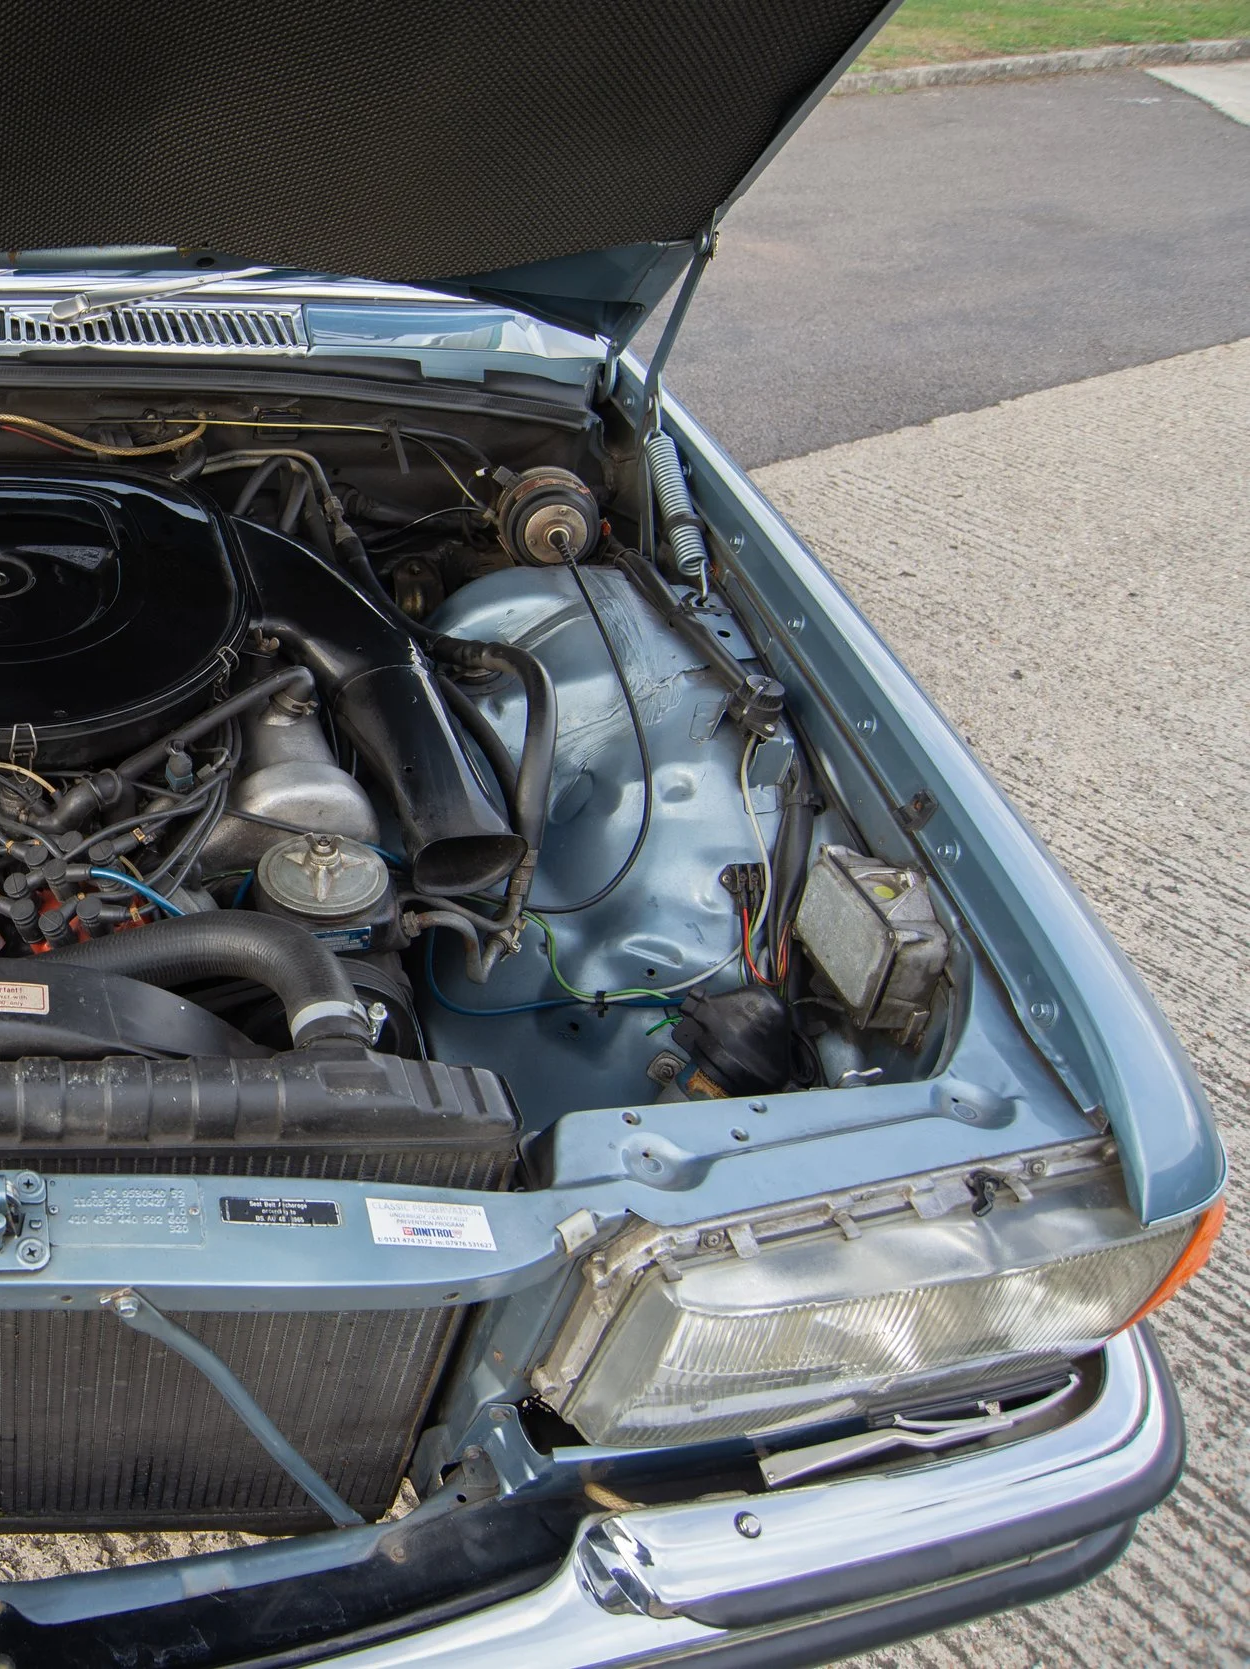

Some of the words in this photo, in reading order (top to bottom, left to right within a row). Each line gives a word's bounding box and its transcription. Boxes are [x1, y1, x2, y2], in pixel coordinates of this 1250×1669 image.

[372, 1202, 411, 1211] CLASSIC
[412, 1204, 482, 1216] PRESERVATION
[435, 1220, 465, 1228] PROGRAM
[412, 1226, 454, 1239] DINITROL
